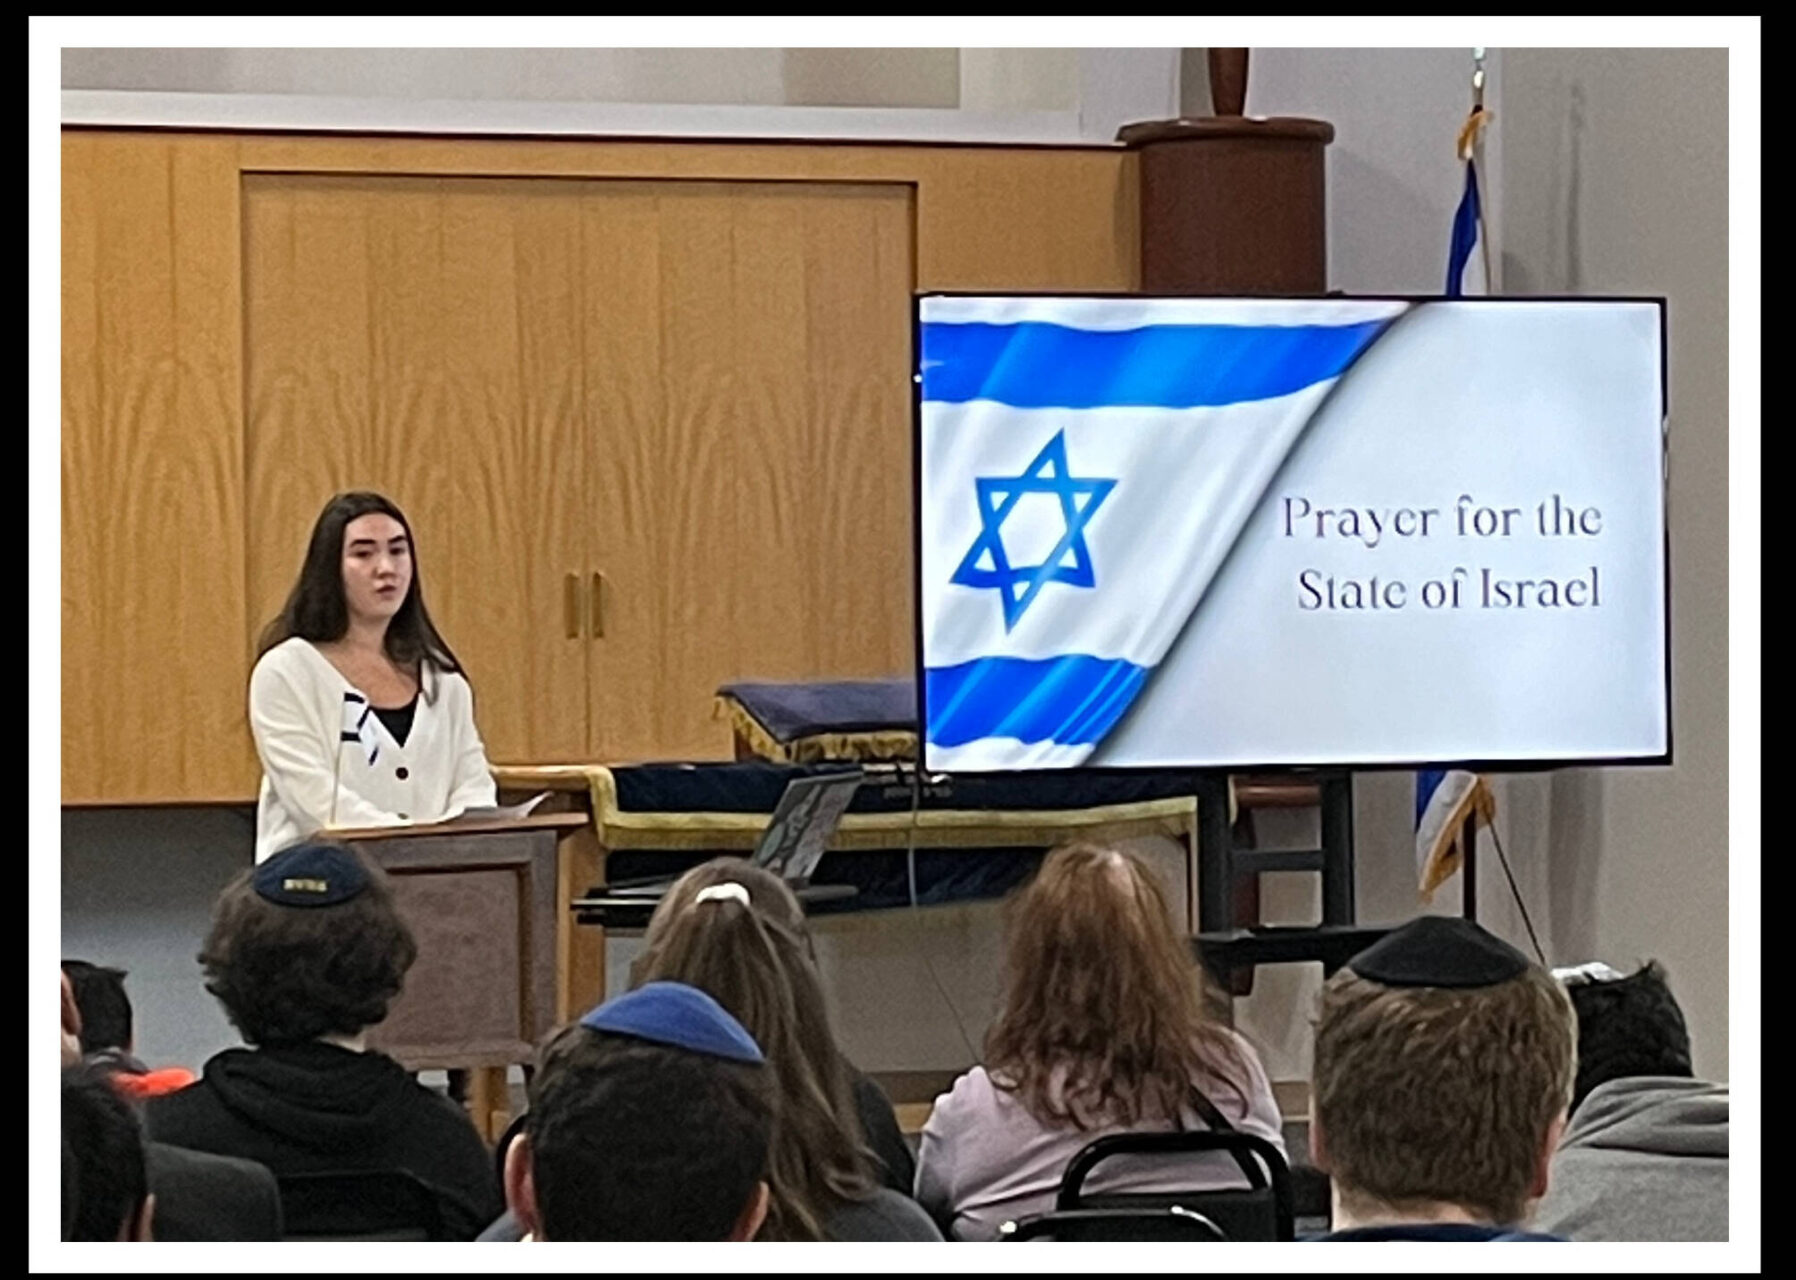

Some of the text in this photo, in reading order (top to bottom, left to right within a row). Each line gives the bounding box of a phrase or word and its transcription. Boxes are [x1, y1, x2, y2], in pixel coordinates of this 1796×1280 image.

[1284, 493, 1603, 549] Prayer for the
[1298, 566, 1601, 610] State of Israel
